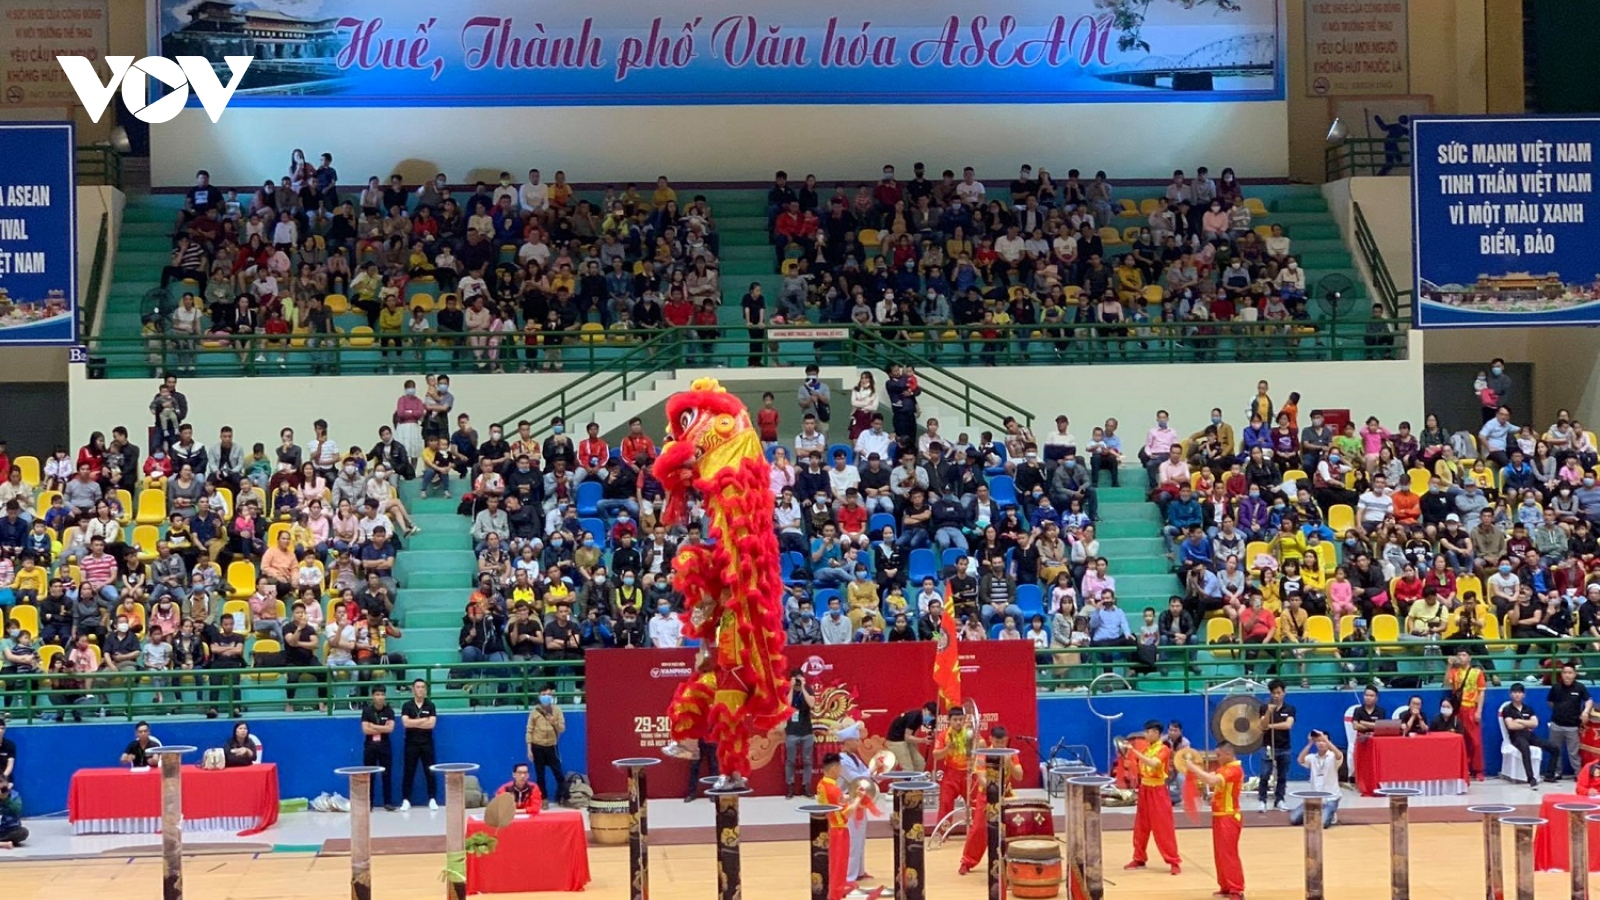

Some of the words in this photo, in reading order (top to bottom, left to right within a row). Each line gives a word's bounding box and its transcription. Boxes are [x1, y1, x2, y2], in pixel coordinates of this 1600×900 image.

[334, 16, 444, 80] Huế,
[461, 15, 605, 70] Thành
[614, 16, 701, 82] phố
[711, 15, 810, 68] Văn
[820, 16, 900, 67] hóa
[909, 14, 1114, 68] ASEAN
[1438, 140, 1468, 164] SỨC
[1472, 143, 1518, 168] MẠNH
[1521, 139, 1553, 167] VIỆT
[1556, 142, 1592, 163] NAM
[8, 185, 50, 207] ASEAN
[1439, 174, 1475, 195] TINH
[1477, 167, 1518, 194] THẦN
[1521, 169, 1553, 198] VIỆT
[1556, 173, 1592, 193] NAM
[1449, 201, 1464, 225] VÌ
[1468, 200, 1501, 229] MỘT
[1504, 200, 1539, 224] MÀU
[1542, 203, 1584, 224] XANH
[1480, 227, 1521, 257] BIỂN,
[1524, 228, 1555, 255] ĐẢO
[15, 252, 46, 274] NAM
